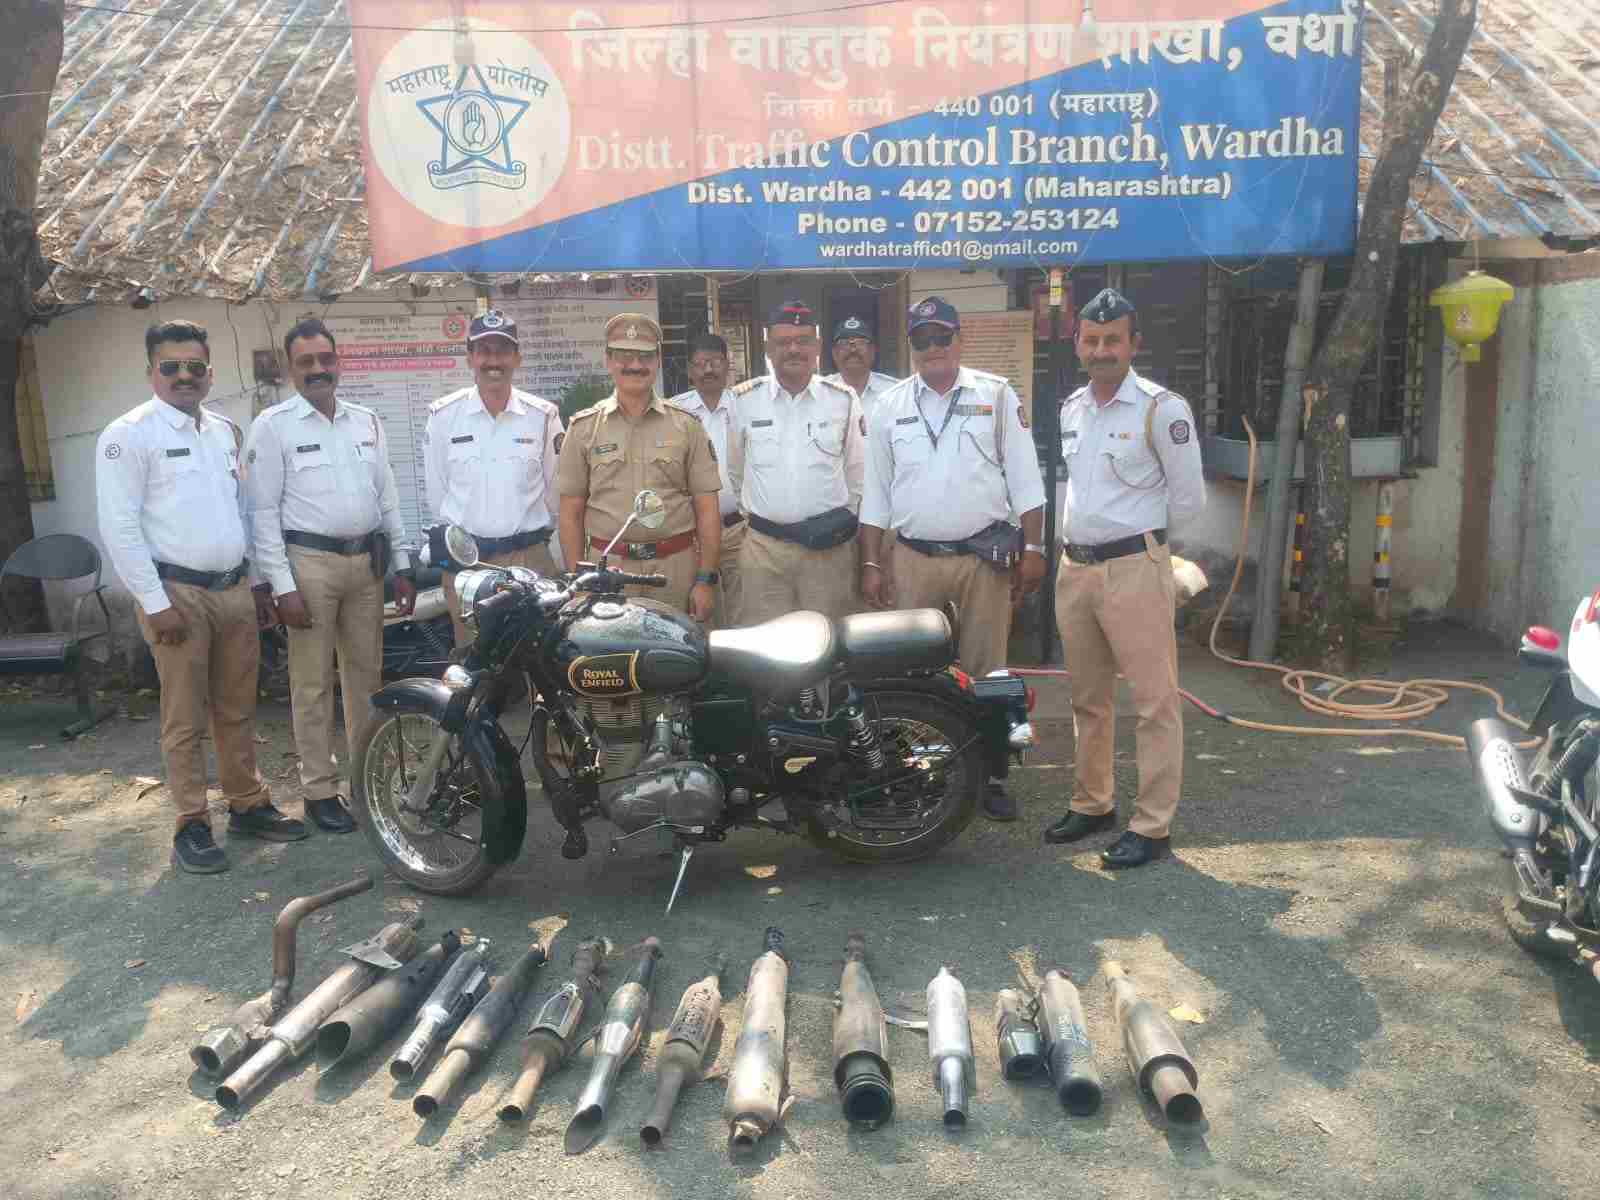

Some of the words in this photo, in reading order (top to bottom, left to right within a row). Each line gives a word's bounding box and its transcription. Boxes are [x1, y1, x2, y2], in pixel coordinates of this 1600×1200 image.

[563, 8, 711, 79] जिल्हा
[908, 3, 1074, 72] नियंत्रण
[1095, 20, 1243, 71] शाखा,
[1261, 0, 1358, 59] वर्धा
[385, 64, 453, 97] महाराष्ट्र
[487, 57, 550, 97] पोलीस
[933, 93, 981, 117] 440
[989, 93, 1034, 116] 001
[1049, 87, 1160, 120] (महाराष्ट्र)
[575, 128, 689, 171] Distt.
[695, 127, 832, 170] Traffic
[841, 126, 998, 168] Control
[1008, 121, 1168, 170] Branch,
[1180, 116, 1345, 161] Wardha
[687, 181, 753, 204] Dist.
[761, 179, 872, 203] Wardha
[898, 179, 953, 201] 442
[961, 177, 1013, 201] 001
[1023, 171, 1233, 204] (Maharashtra)
[797, 211, 888, 235] Phone
[914, 207, 1120, 234] 07152-253124
[819, 237, 1079, 261] wardhatraffic01@gmail.com
[581, 678, 625, 688] ENFIELD
[583, 668, 619, 679] ROYAL
